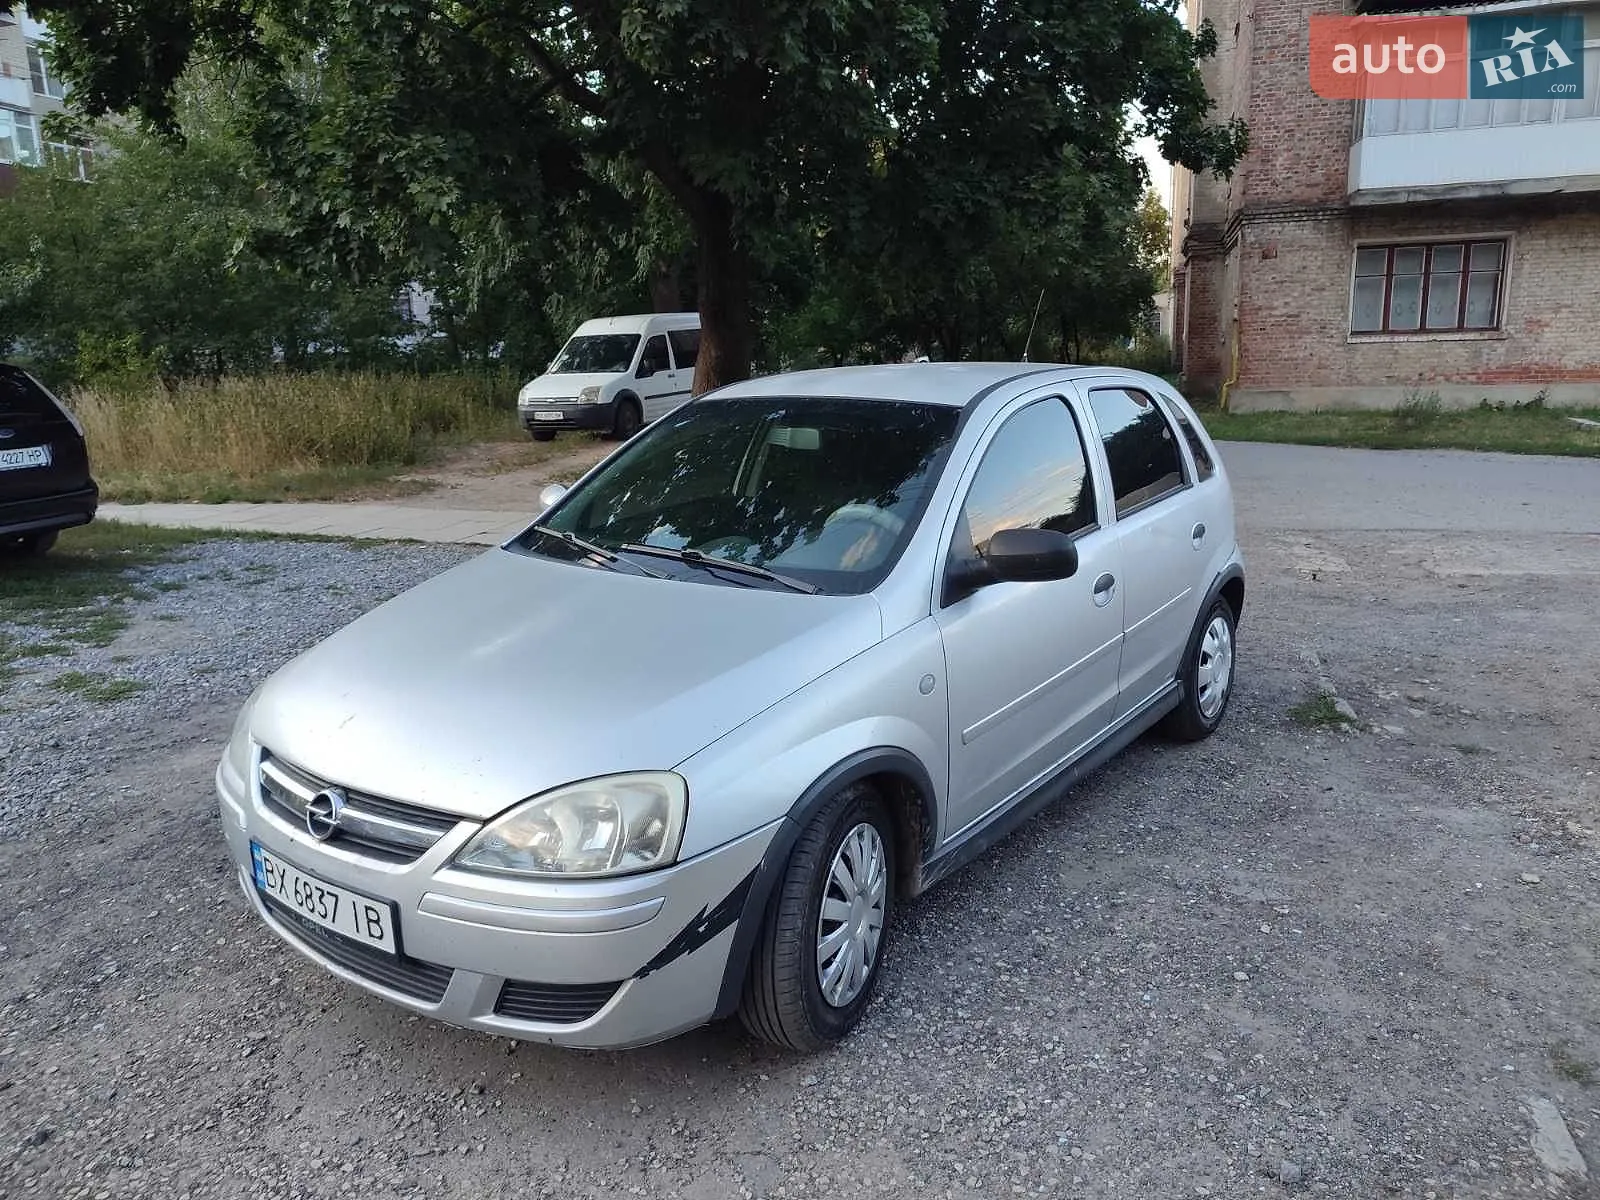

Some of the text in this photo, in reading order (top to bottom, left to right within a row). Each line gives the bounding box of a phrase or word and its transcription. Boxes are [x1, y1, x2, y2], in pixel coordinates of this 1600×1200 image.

[263, 856, 385, 941] BX 6837 IB
